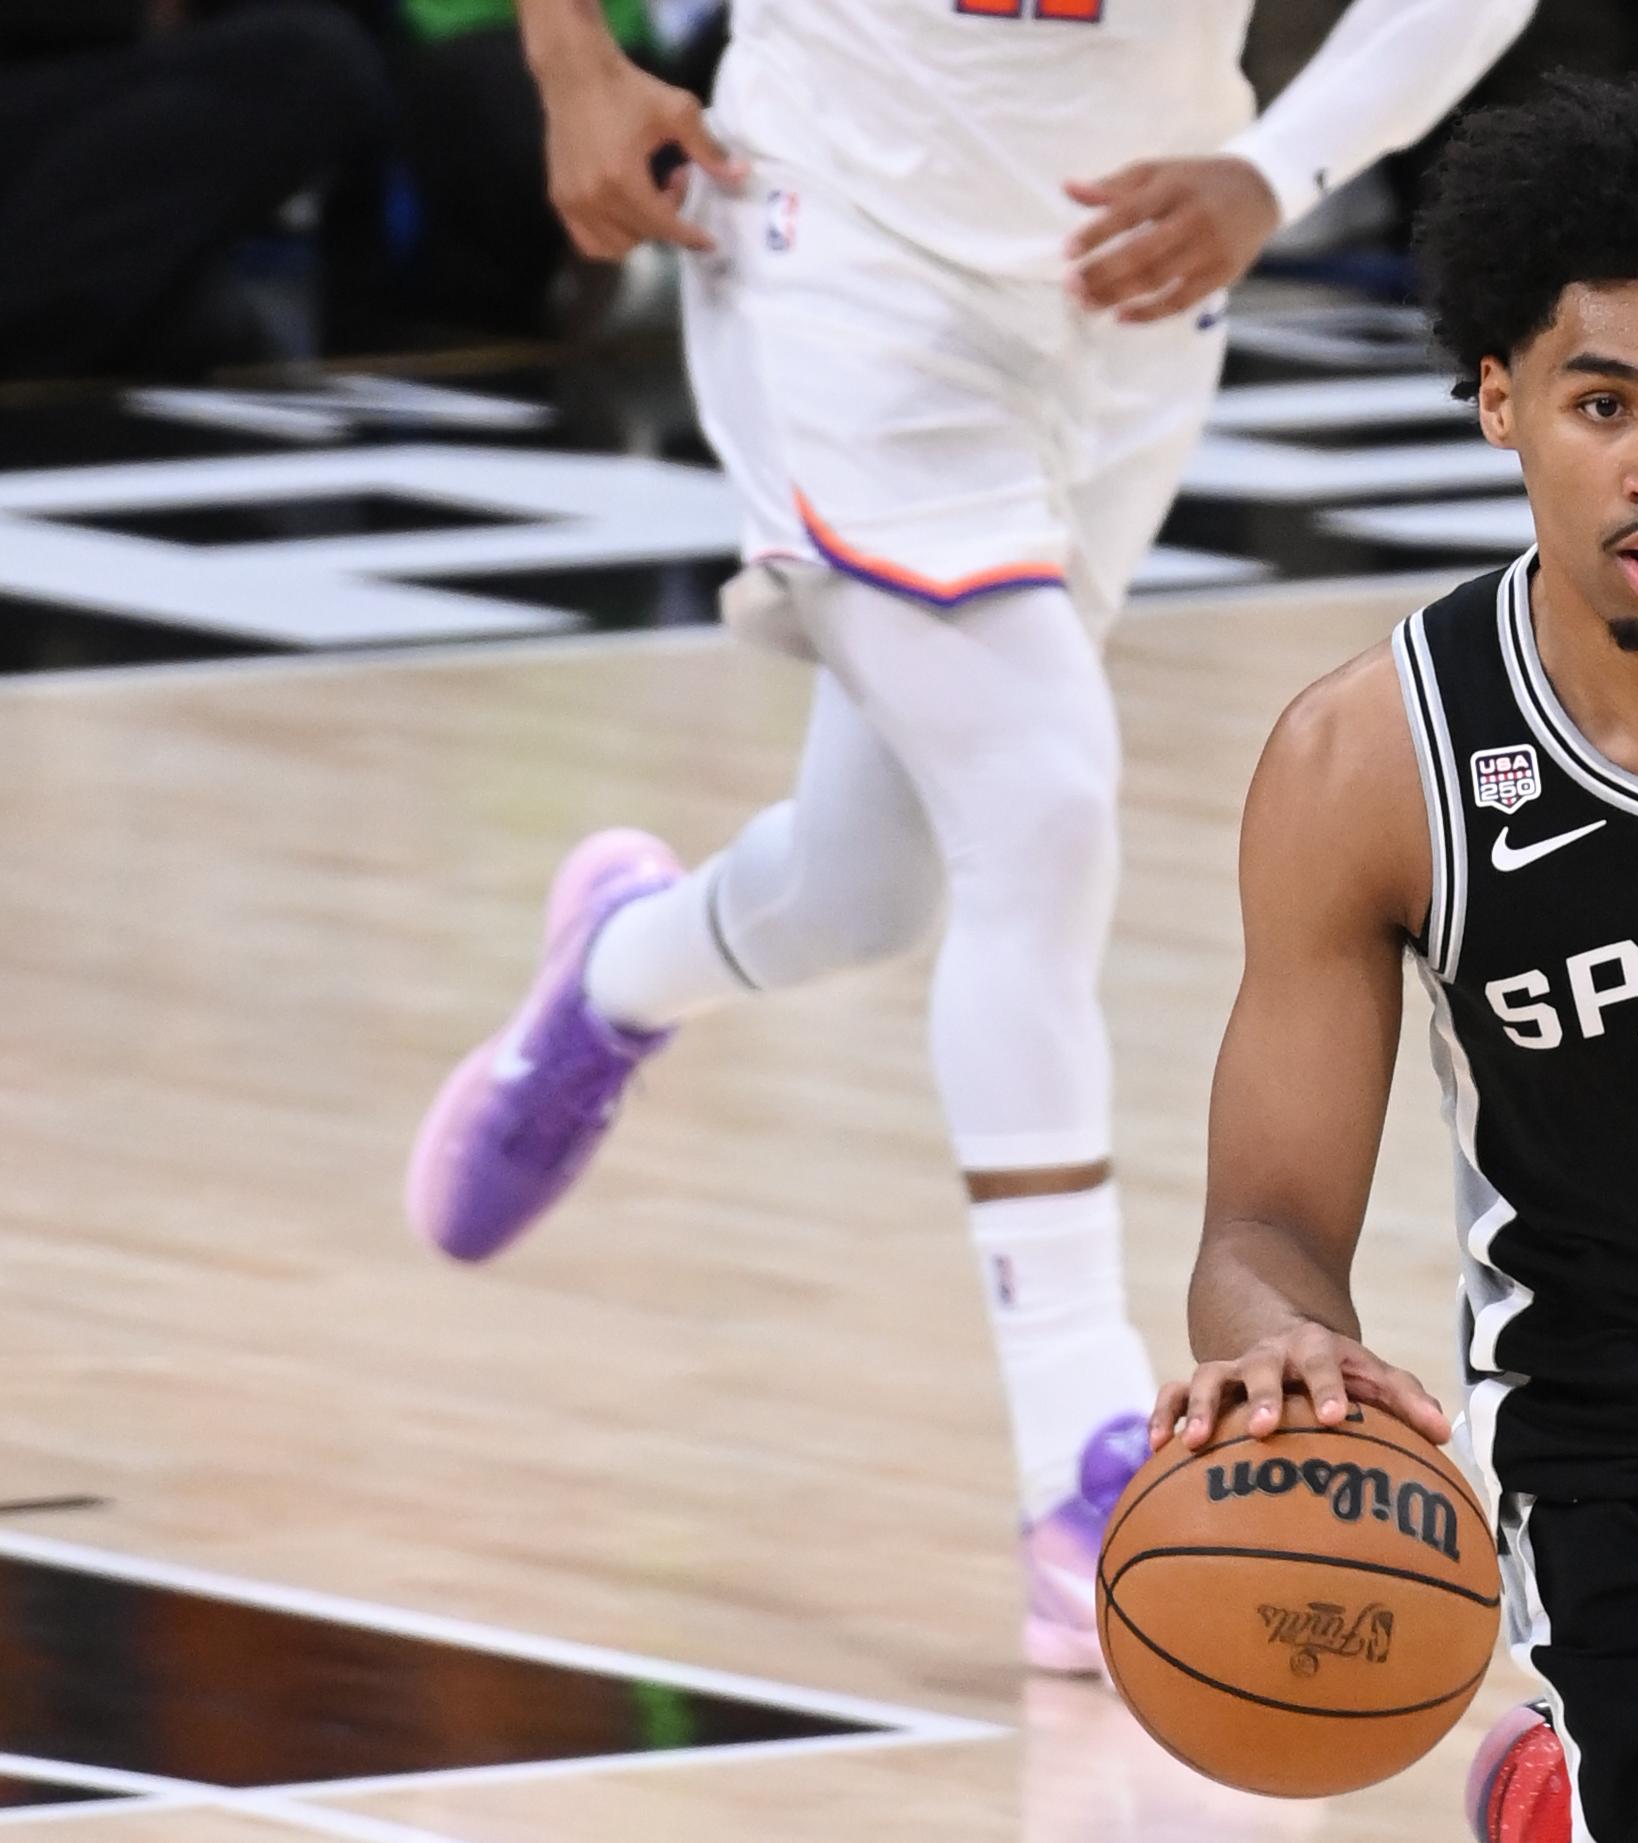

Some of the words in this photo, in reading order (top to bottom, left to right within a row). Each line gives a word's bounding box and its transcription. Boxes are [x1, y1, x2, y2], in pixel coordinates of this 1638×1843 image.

[1479, 755, 1529, 774] USA
[1481, 779, 1536, 801] 250
[1206, 1456, 1461, 1564] Wilson
